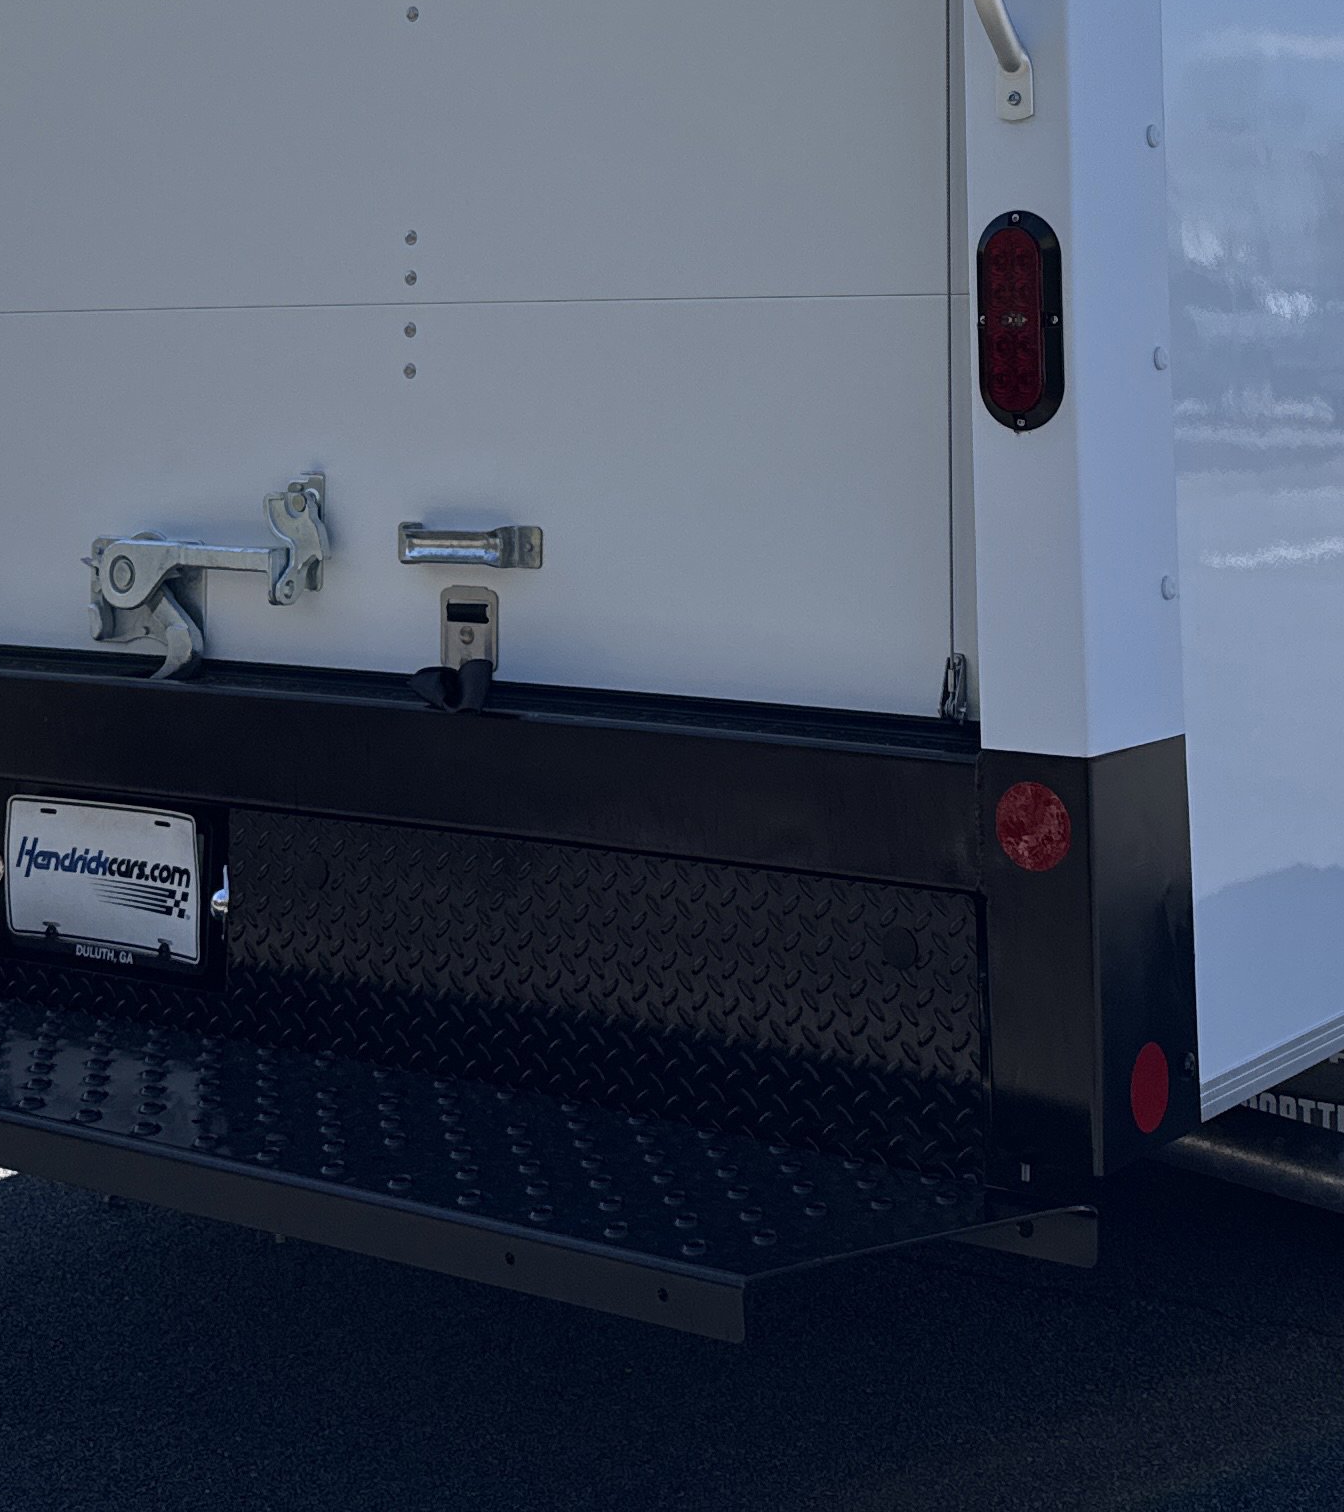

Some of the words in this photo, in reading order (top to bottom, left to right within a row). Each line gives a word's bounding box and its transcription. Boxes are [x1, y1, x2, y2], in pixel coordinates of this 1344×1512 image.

[16, 836, 191, 888] Hendrickcars.com
[75, 944, 117, 963] DULUTH,
[119, 952, 134, 964] GA
